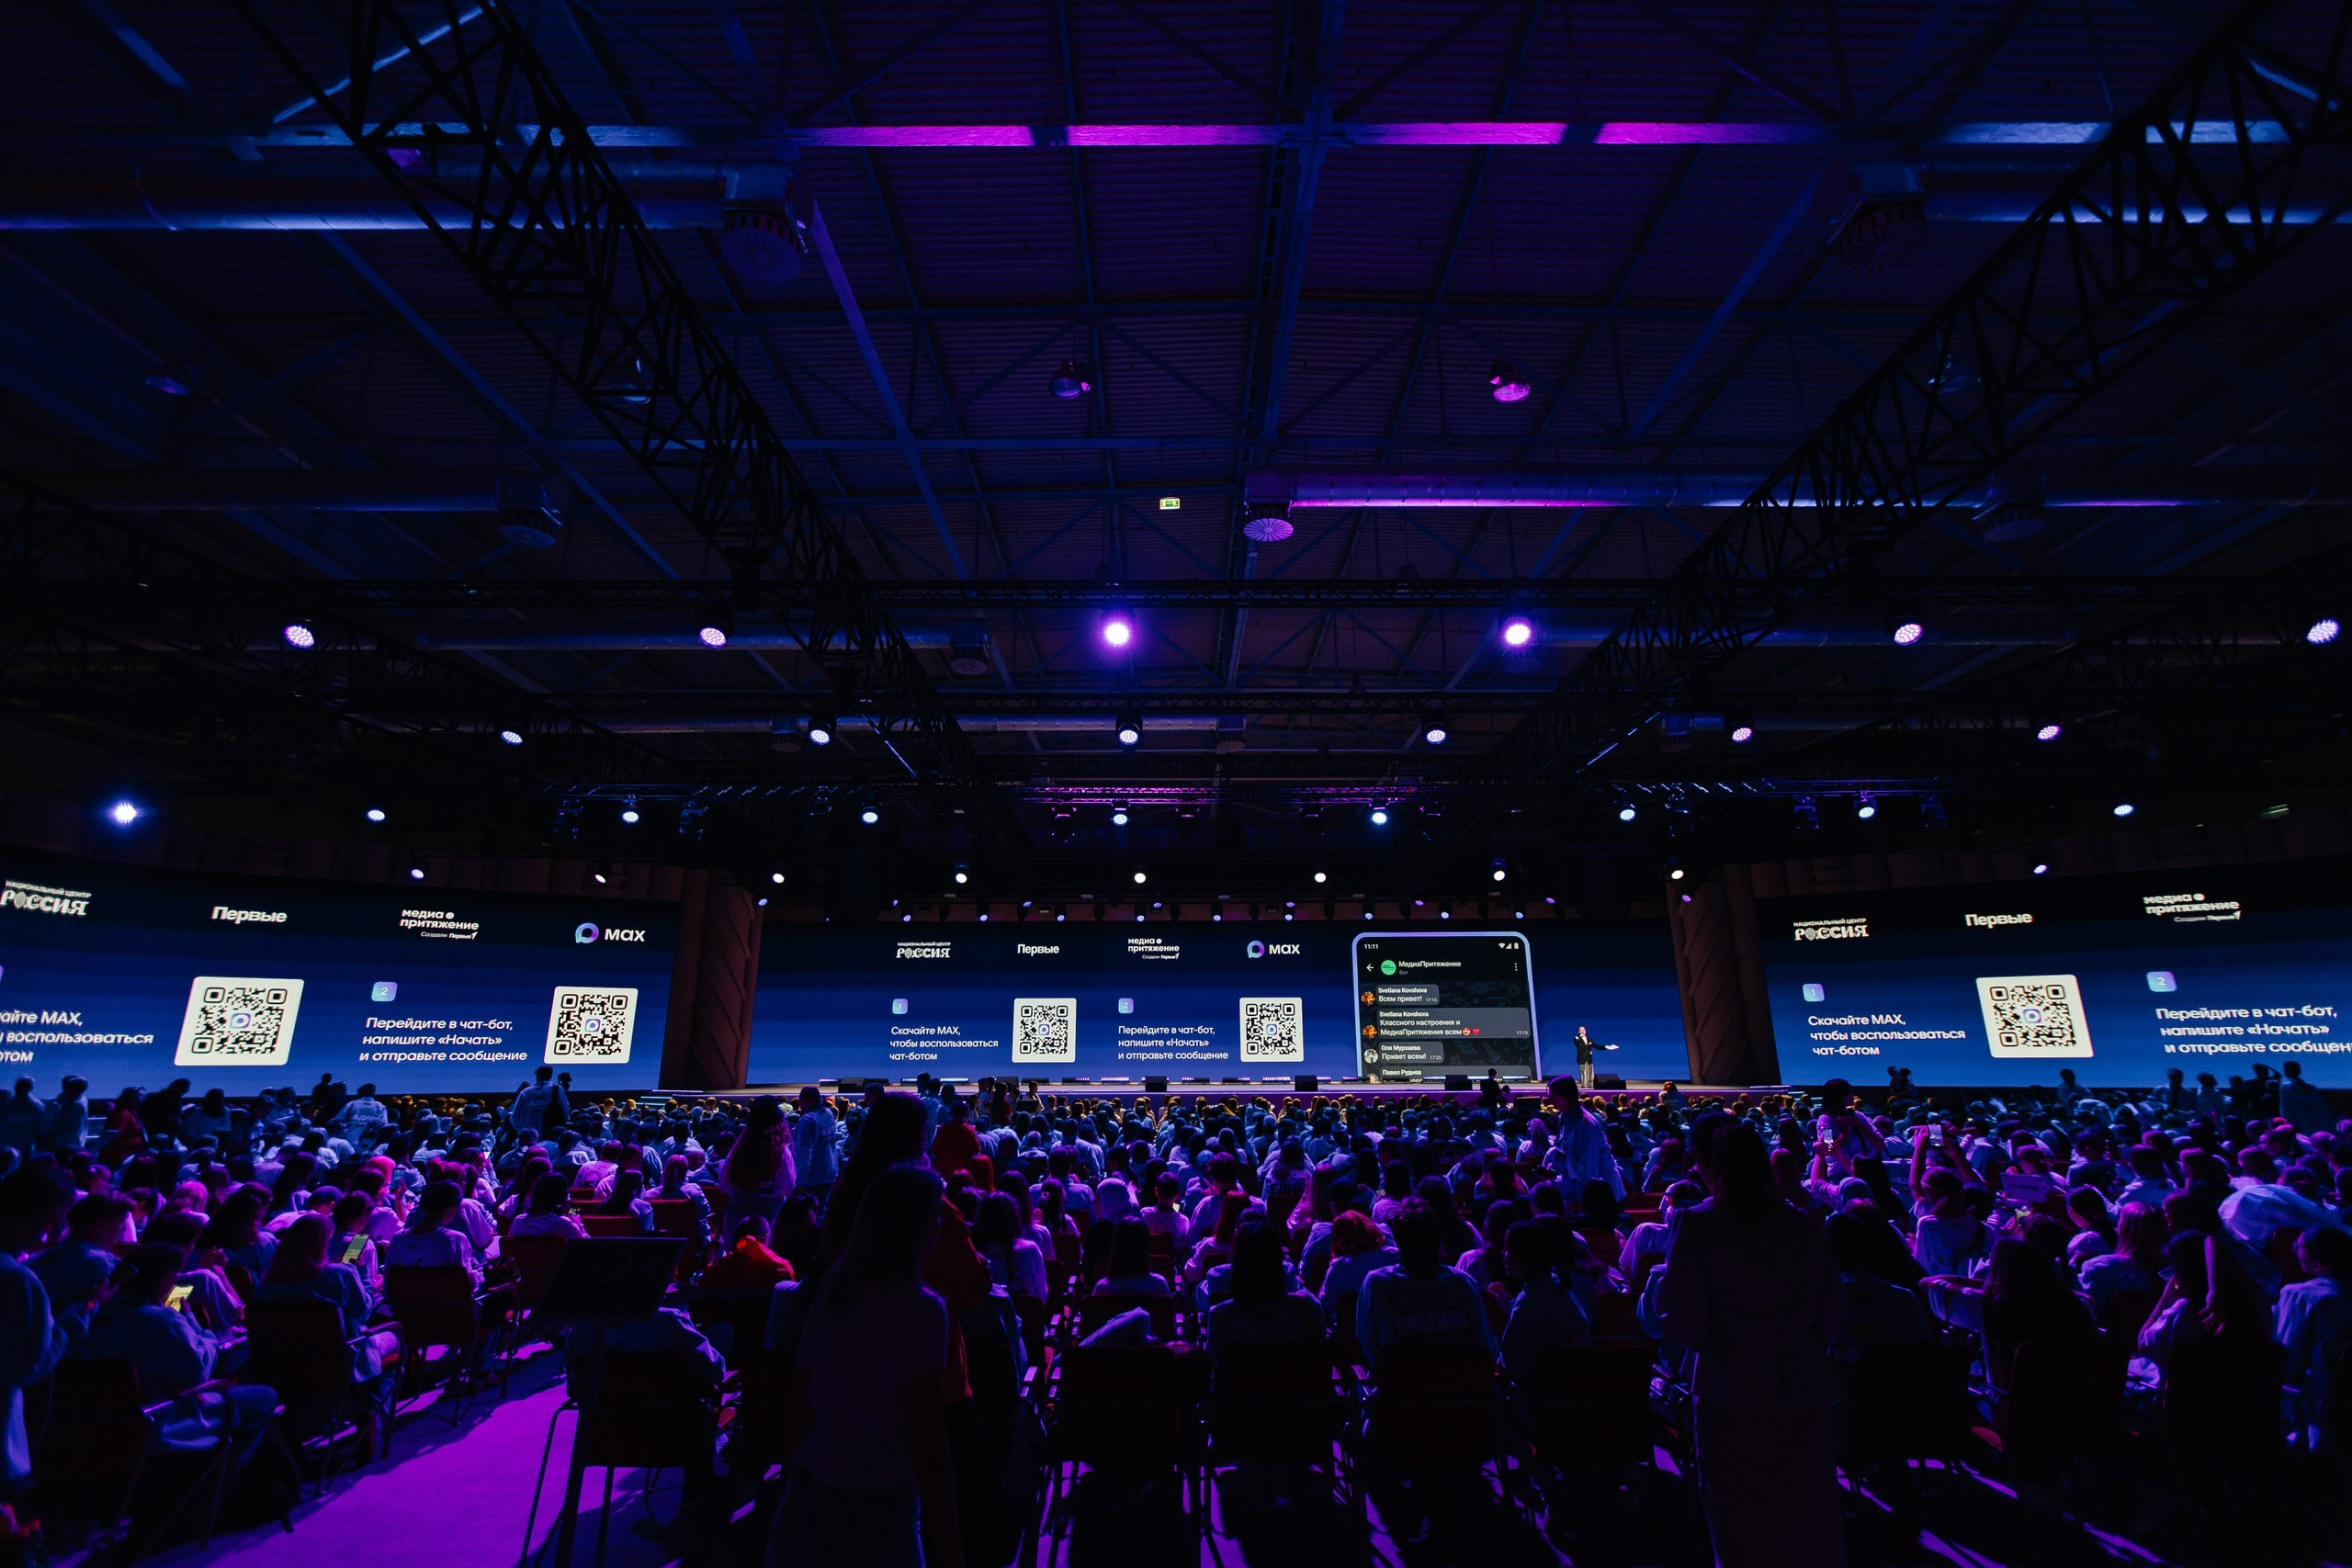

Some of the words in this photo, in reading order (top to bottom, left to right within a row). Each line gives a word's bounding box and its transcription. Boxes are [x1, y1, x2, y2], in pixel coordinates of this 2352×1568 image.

[2143, 894, 2193, 904] медиа
[2145, 901, 2240, 915] притяжение
[211, 906, 288, 924] Первые
[401, 909, 444, 919] медиа
[400, 919, 480, 930] притяжение
[1965, 912, 2033, 929] Первые
[1017, 943, 1059, 956] Первые
[2158, 977, 2166, 986] 2
[381, 987, 389, 996] 2
[2155, 1007, 2249, 1021] Перейдите
[2252, 1009, 2262, 1017] в
[2265, 1005, 2337, 1019] чат-бот,
[366, 1017, 447, 1031] Перейдите
[449, 1020, 457, 1029] в
[459, 1018, 514, 1031] чат-бот,
[1808, 1015, 1870, 1026] Скачайте
[891, 1026, 935, 1035] Скачайте
[1118, 1026, 1169, 1036] Перейдите
[1178, 1026, 1216, 1035] чат-бот,
[2160, 1025, 2244, 1036] напишите
[2246, 1023, 2329, 1035] «Начать»
[6, 1031, 154, 1044] воспользоваться
[362, 1034, 436, 1046] напишите
[438, 1033, 503, 1045] «Начать»
[1810, 1031, 1848, 1041] чтобы
[1851, 1030, 1965, 1041] воспользоваться
[890, 1039, 918, 1048] чтобы
[920, 1040, 999, 1048] воспользоваться
[1118, 1039, 1164, 1048] напишите
[1166, 1039, 1209, 1047] «Начать»
[2165, 1044, 2176, 1053] и
[2177, 1043, 2266, 1055] отправьте
[1813, 1045, 1880, 1055] чат-ботом
[359, 1052, 368, 1061] и
[372, 1051, 447, 1063] отправьте
[449, 1049, 527, 1063] сообщение
[889, 1052, 937, 1061] чат-ботом
[1126, 1053, 1173, 1061] отправьте
[1176, 1051, 1228, 1061] сообщение
